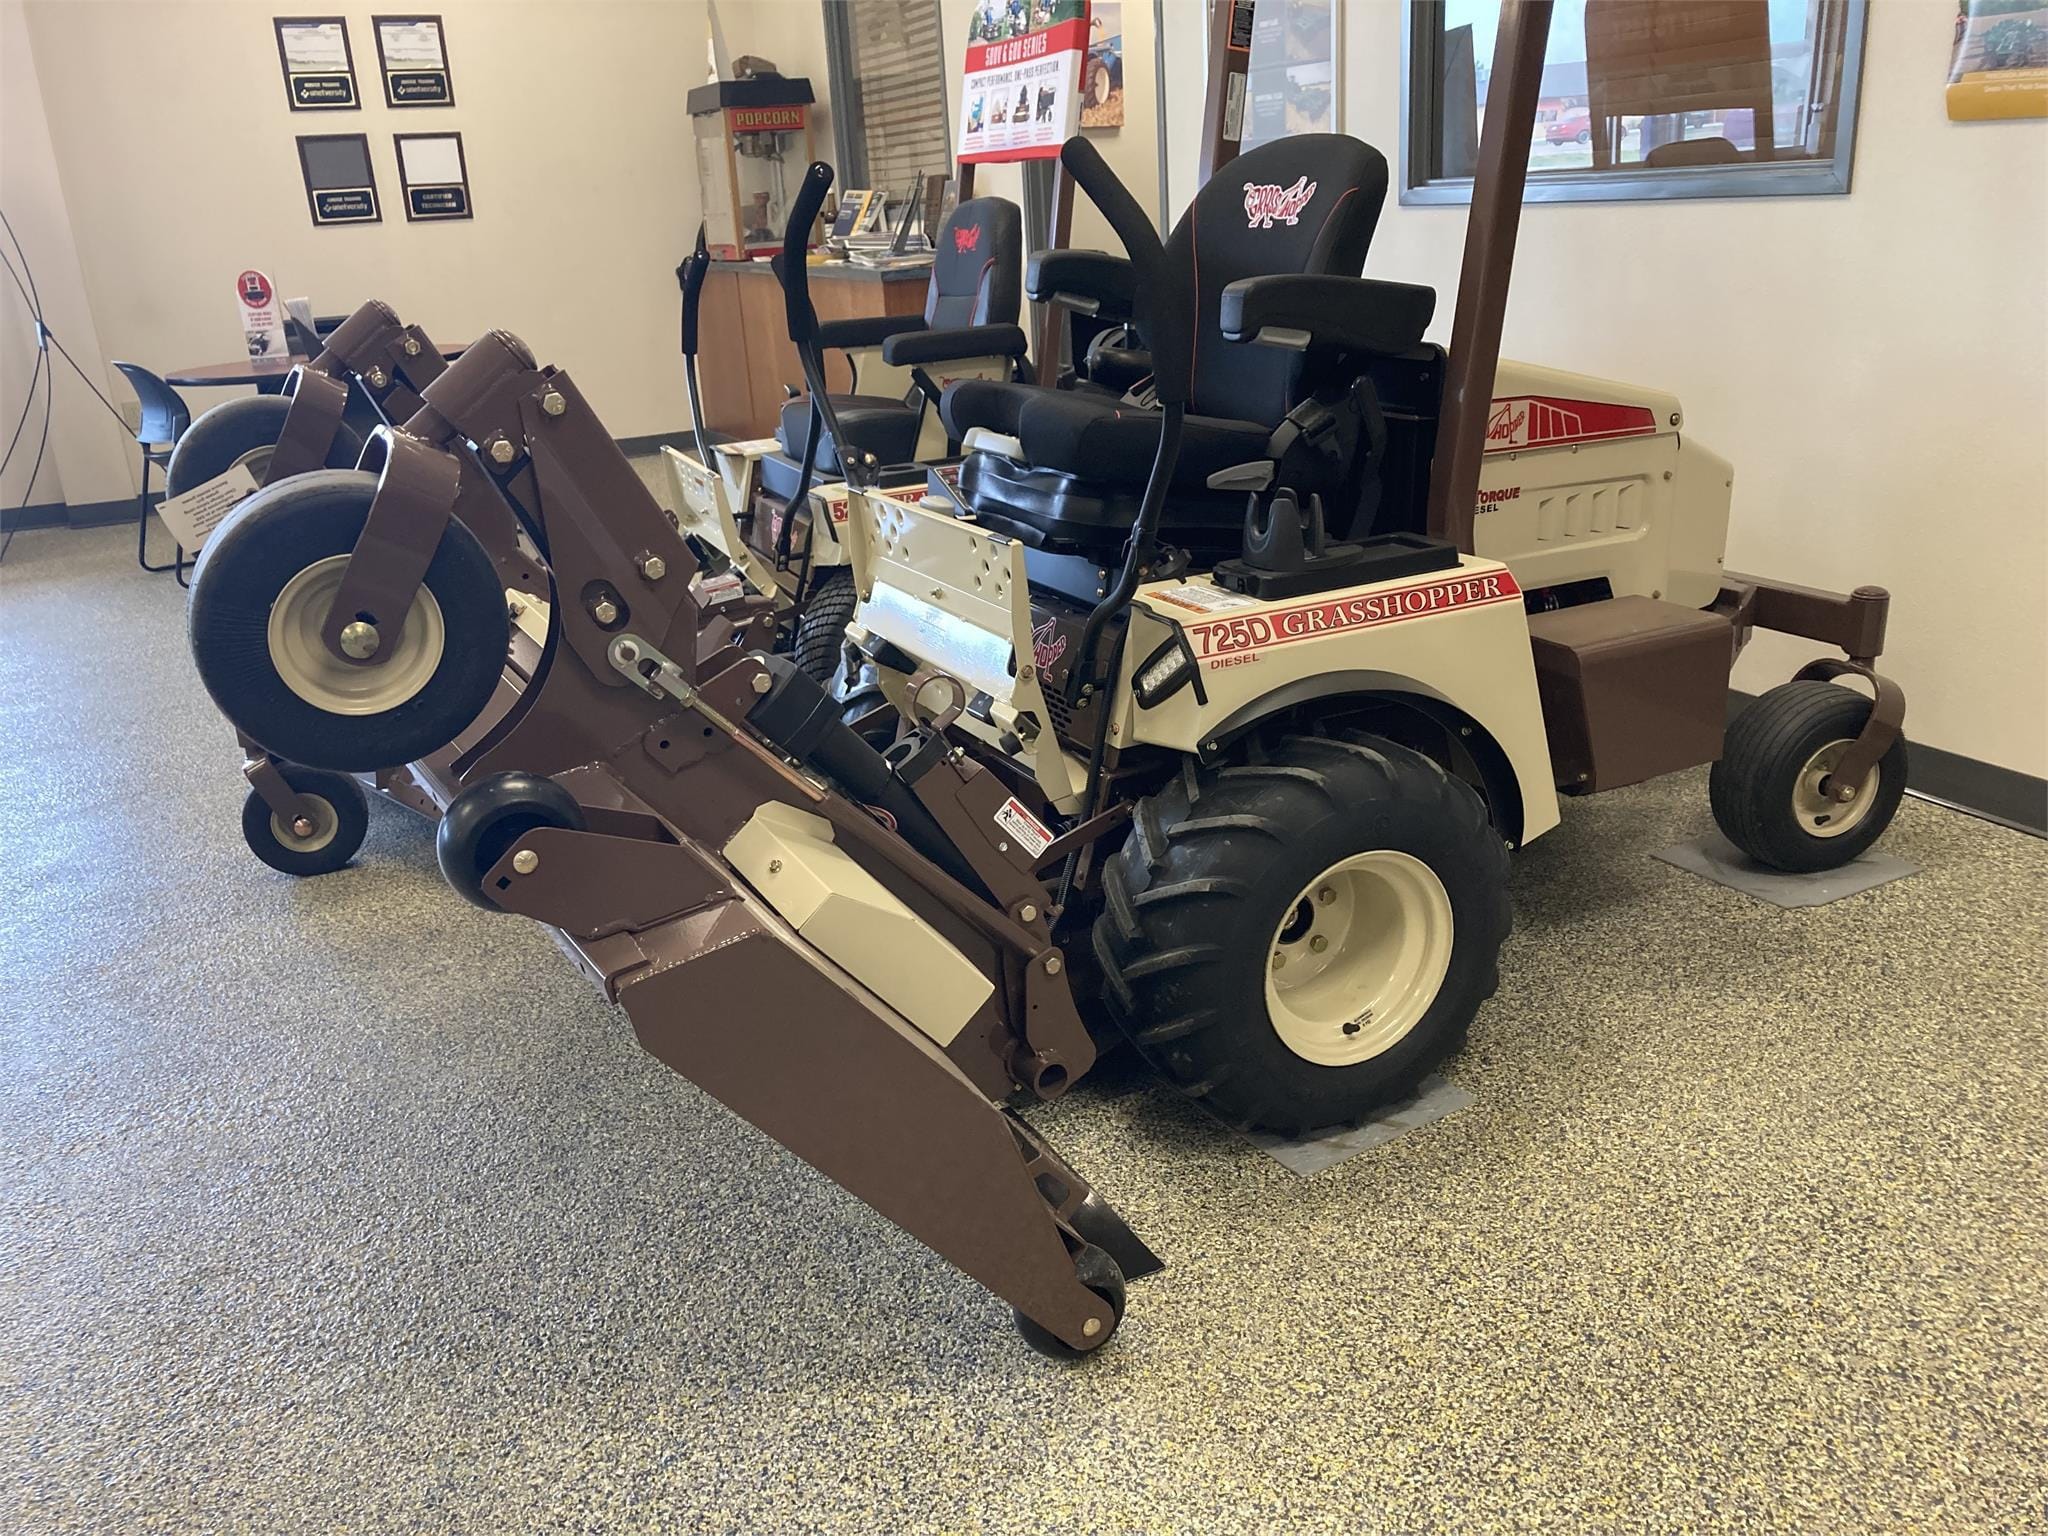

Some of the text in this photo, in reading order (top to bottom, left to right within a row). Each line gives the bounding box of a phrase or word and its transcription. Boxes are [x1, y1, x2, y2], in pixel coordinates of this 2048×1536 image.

[1023, 33, 1047, 57] SERIES
[736, 110, 800, 126] POPCORN
[1192, 576, 1503, 655] 725D GRASSHOPPER
[1210, 653, 1260, 670] DIESEL
